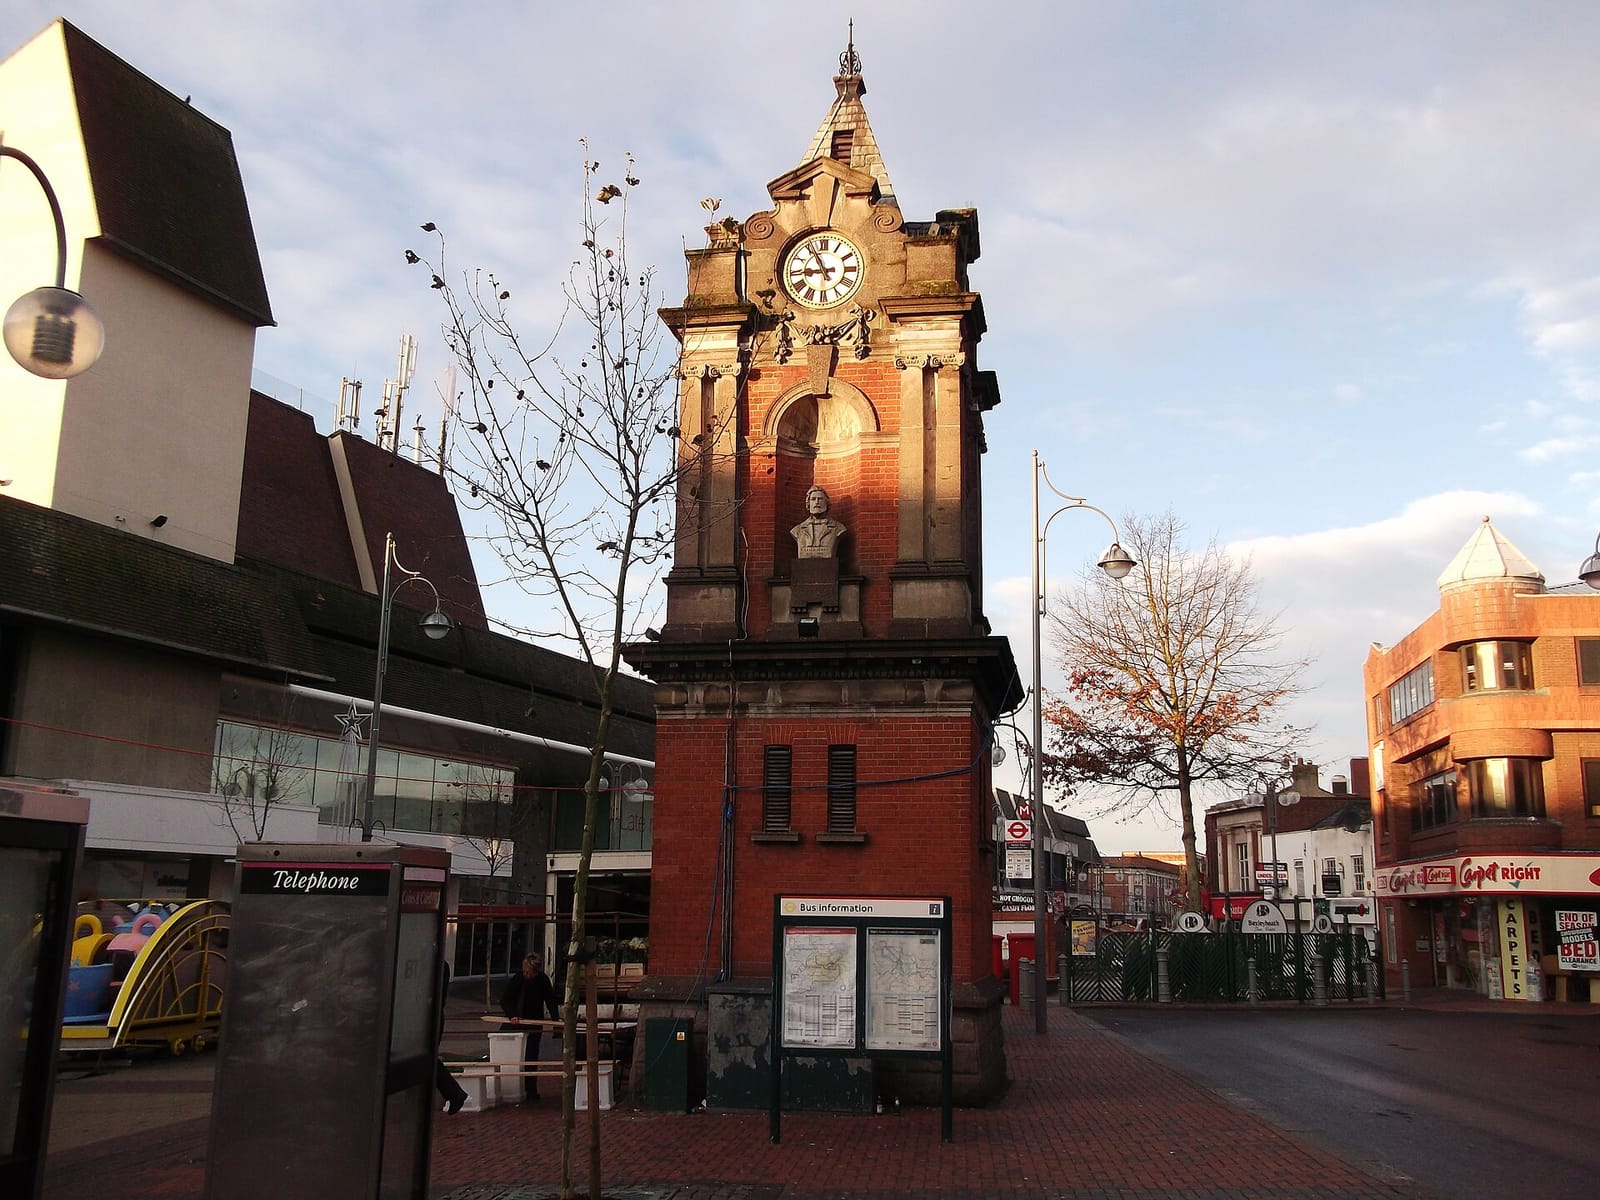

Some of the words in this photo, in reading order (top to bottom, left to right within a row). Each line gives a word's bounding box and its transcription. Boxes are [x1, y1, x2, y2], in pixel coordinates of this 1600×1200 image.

[1019, 806, 1030, 815] M
[1460, 858, 1499, 889] Carpet
[273, 870, 359, 892] Telephone
[800, 904, 816, 912] Bus
[819, 904, 873, 913] information
[1559, 913, 1578, 922] END
[1582, 914, 1594, 922] OF
[1561, 933, 1594, 944] MODELS
[1506, 900, 1521, 994] CARPETS
[1561, 942, 1596, 957] BED
